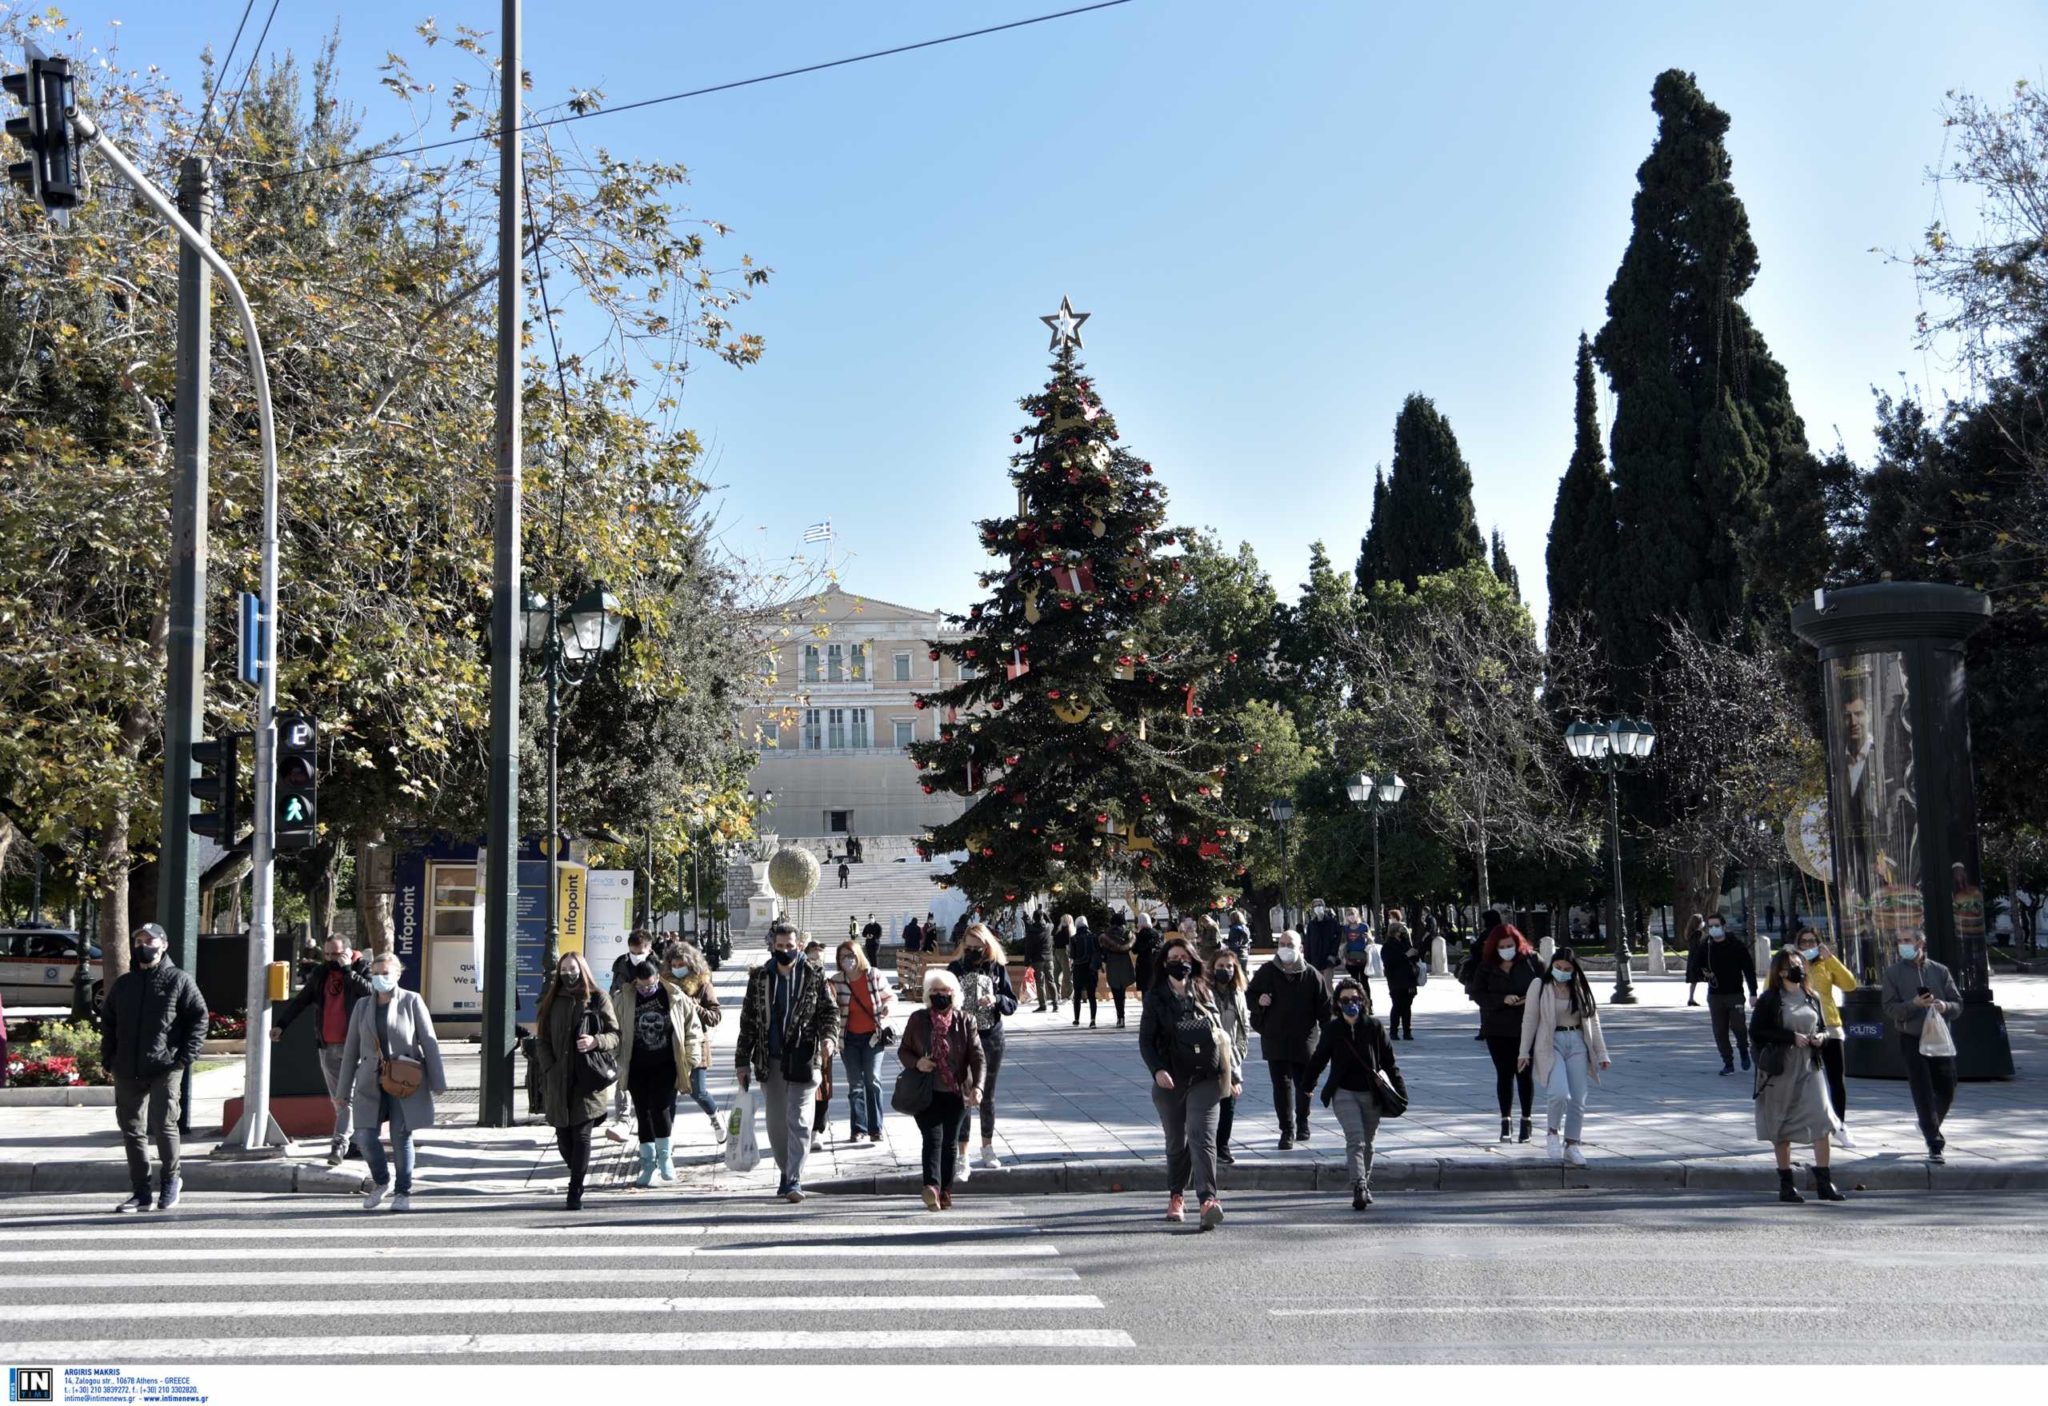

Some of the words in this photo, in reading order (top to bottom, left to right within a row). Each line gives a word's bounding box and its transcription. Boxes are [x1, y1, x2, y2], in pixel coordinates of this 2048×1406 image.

[399, 885, 417, 955] Infopoint
[564, 874, 580, 935] Infopoint
[453, 976, 468, 984] We
